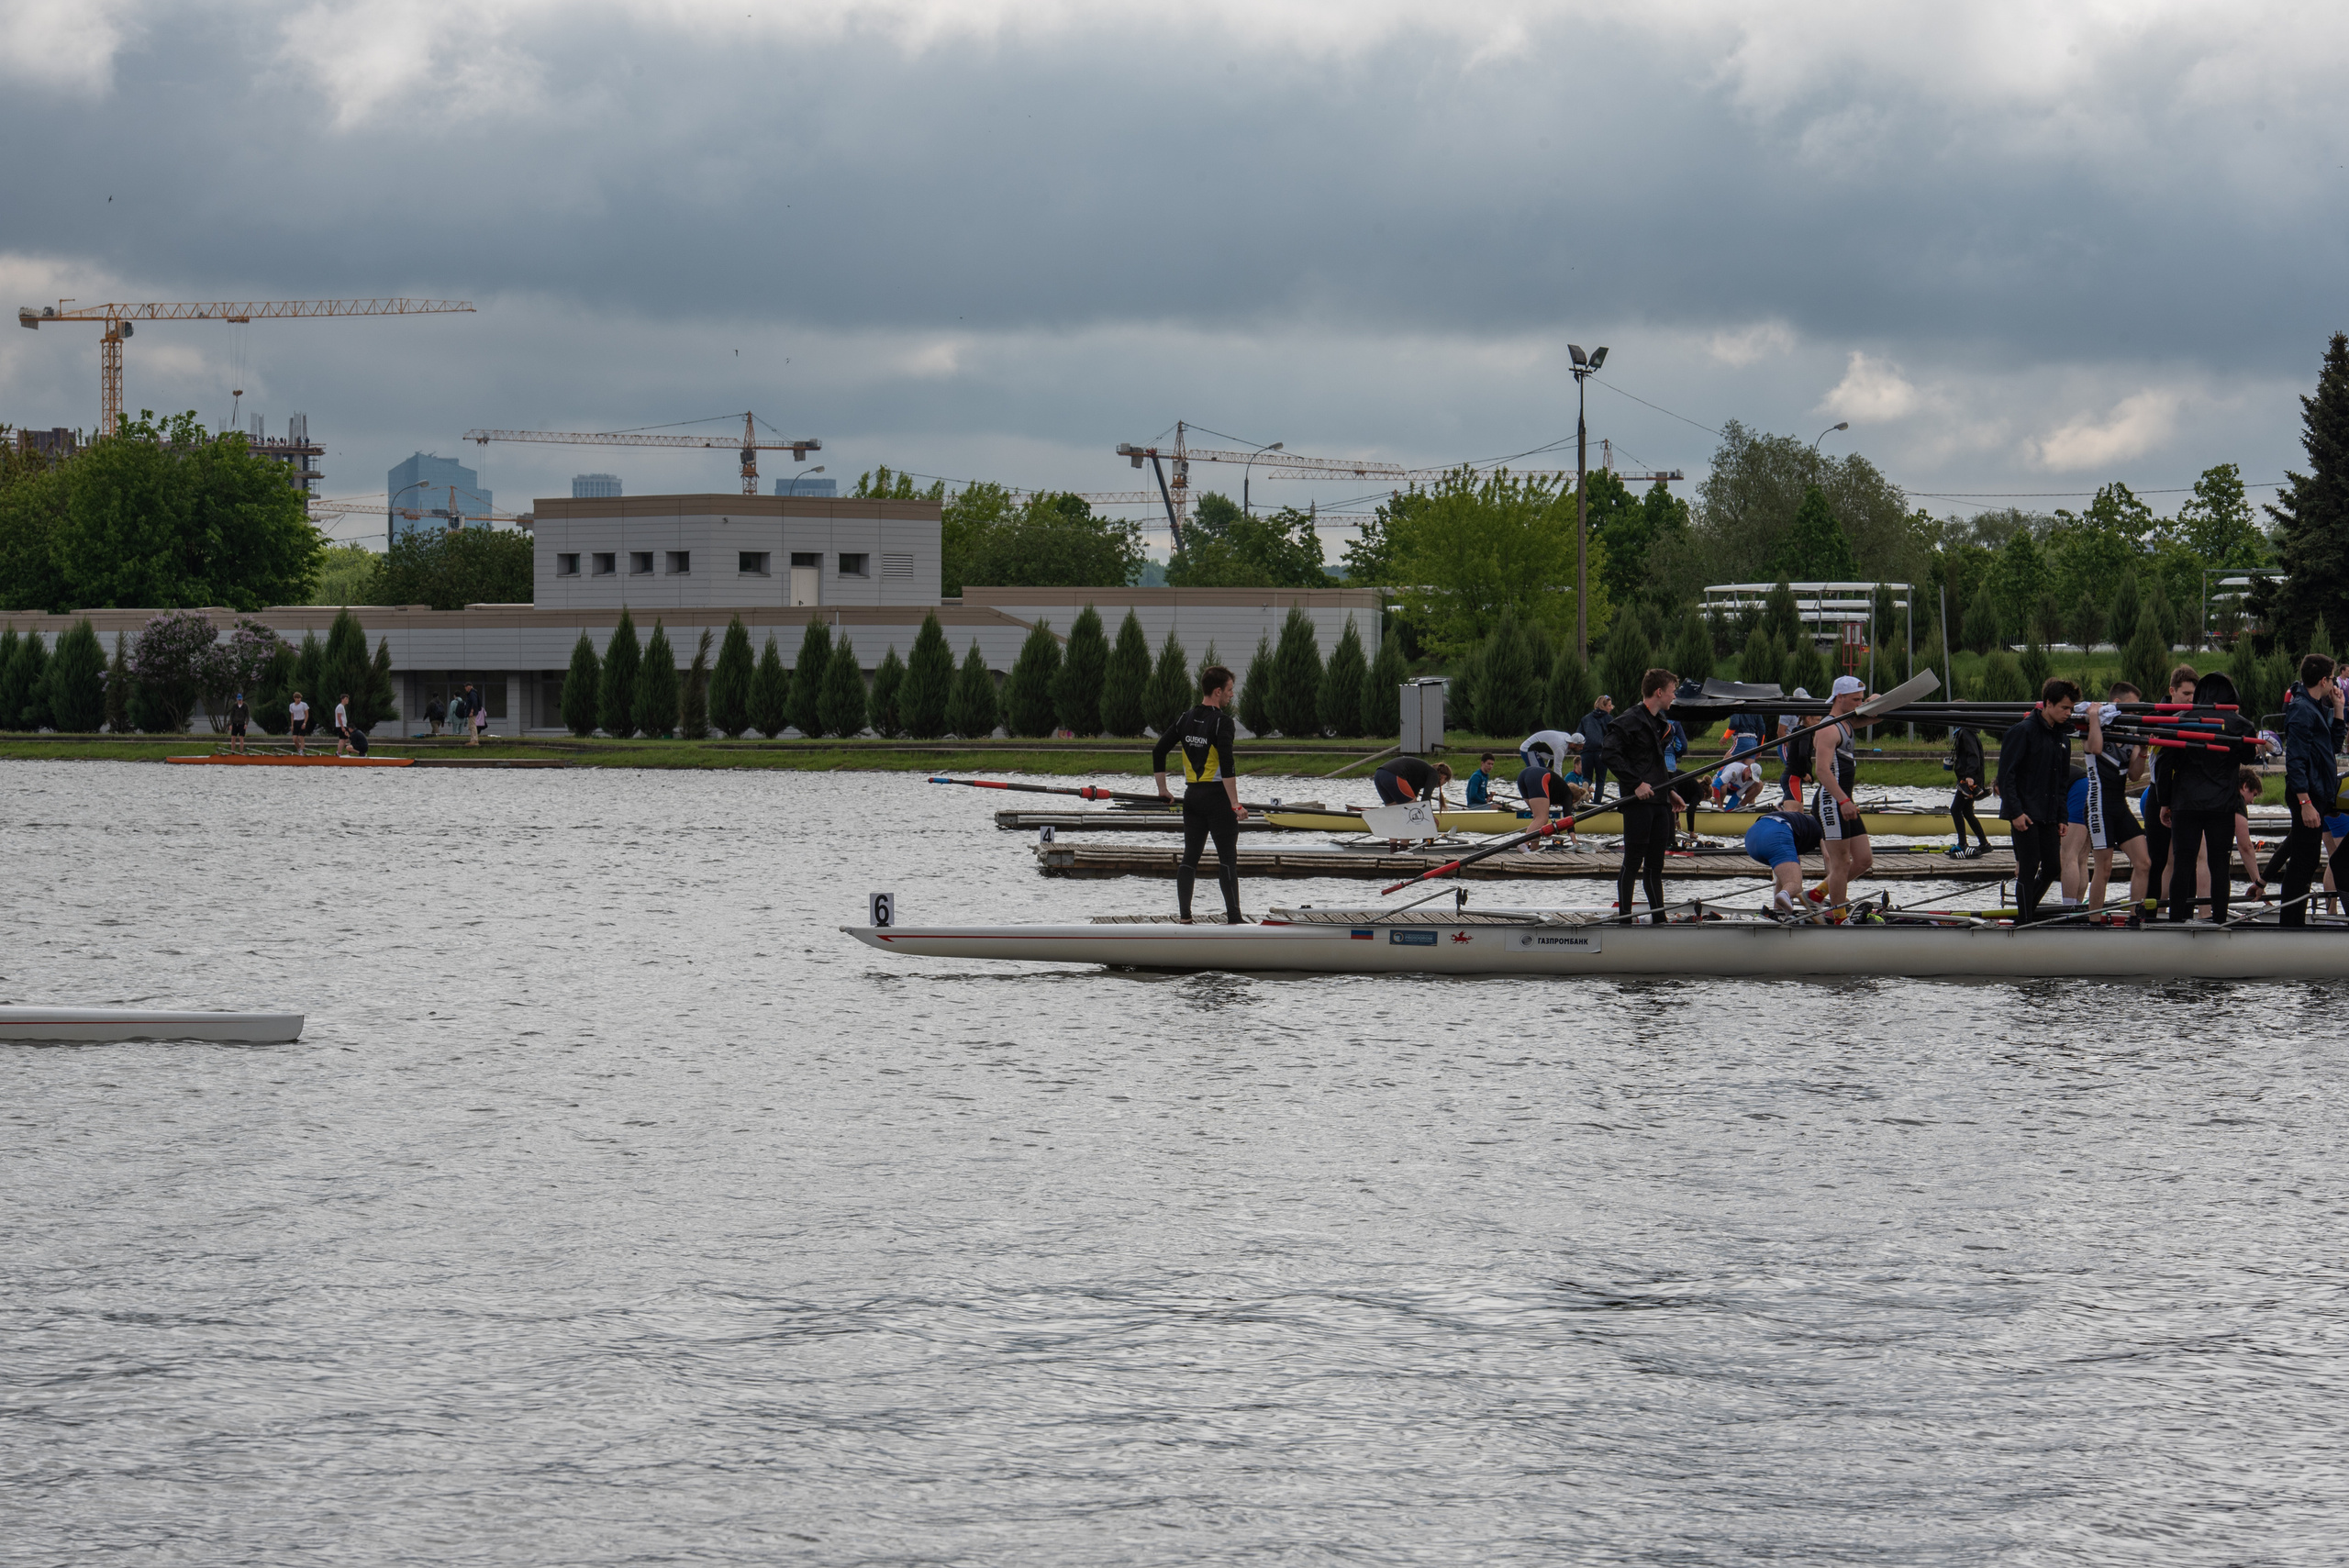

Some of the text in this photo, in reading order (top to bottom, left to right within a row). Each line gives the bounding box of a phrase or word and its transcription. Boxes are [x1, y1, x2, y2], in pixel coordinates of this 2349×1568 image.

[2089, 783, 2099, 812] ROWING
[1823, 806, 1835, 826] CLUB
[2091, 815, 2101, 834] CLUB
[1042, 828, 1052, 842] 4
[874, 894, 889, 923] 6
